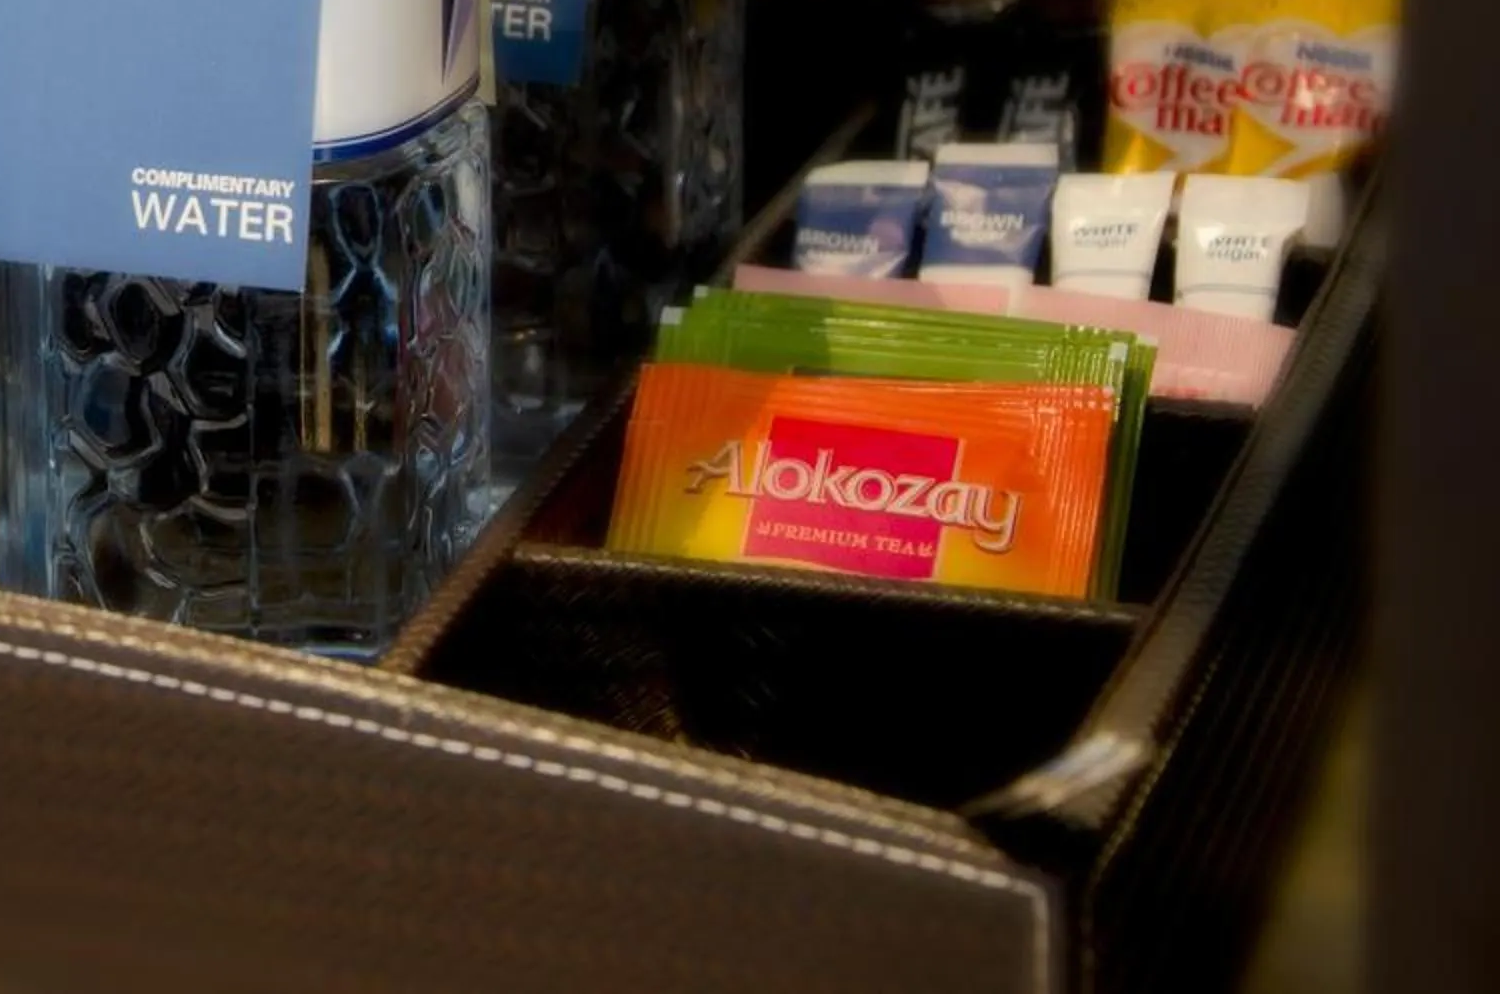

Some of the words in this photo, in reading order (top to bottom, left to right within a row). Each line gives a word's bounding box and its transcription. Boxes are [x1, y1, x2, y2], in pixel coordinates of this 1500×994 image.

[132, 167, 295, 198] COMPLIMENTARY
[132, 190, 293, 244] WATER
[940, 210, 1025, 230] BROWN
[1073, 222, 1139, 237] WHITE
[798, 228, 879, 254] BROWN
[1208, 235, 1269, 248] WHITE
[684, 440, 1022, 553] Alokozay
[773, 523, 868, 548] PREMIUM
[875, 536, 915, 555] TEA
